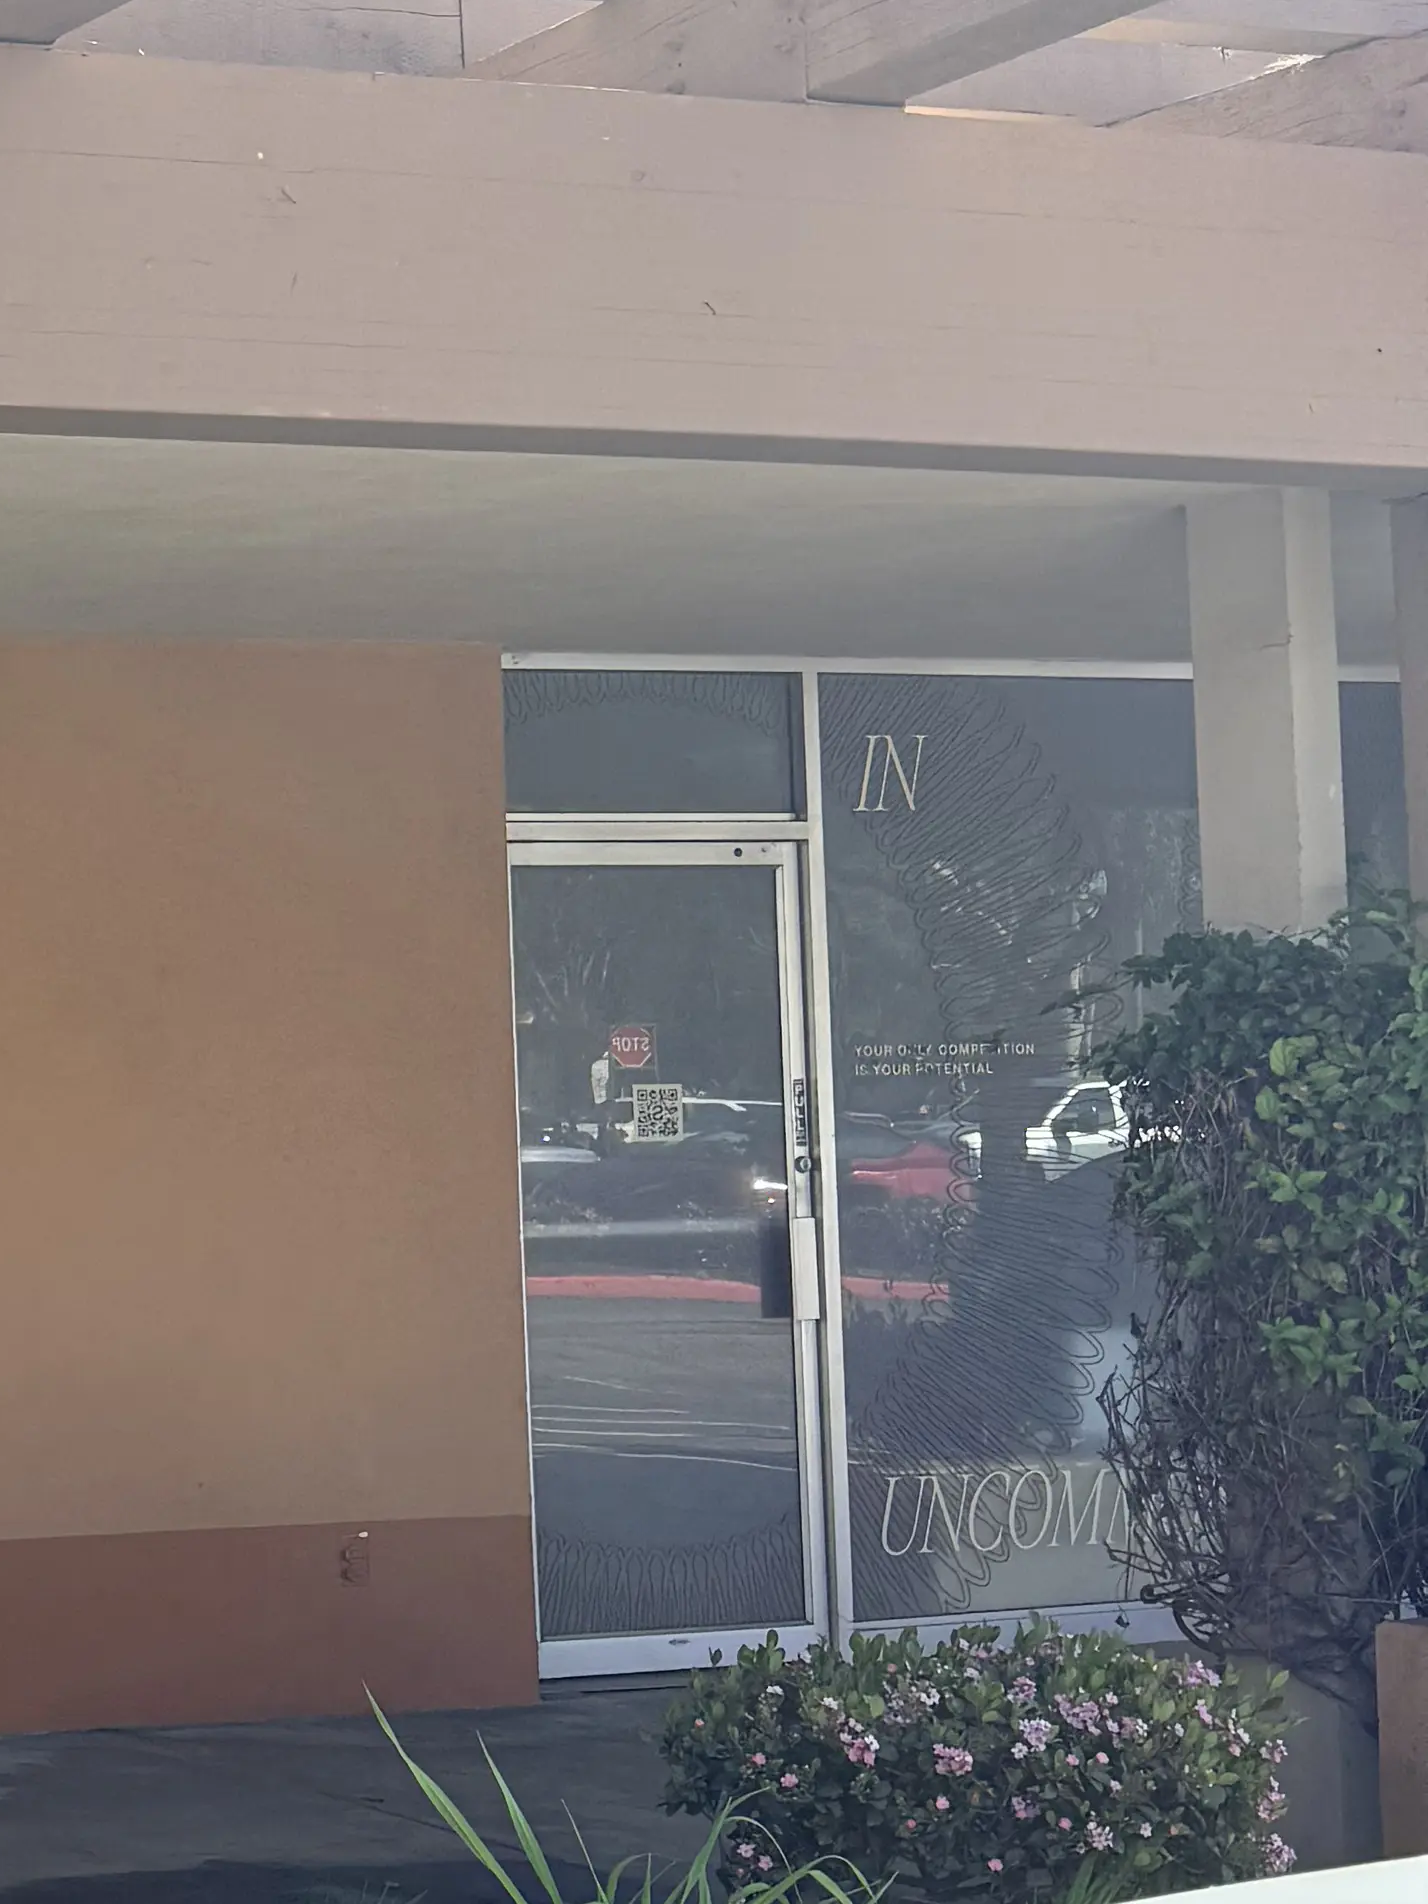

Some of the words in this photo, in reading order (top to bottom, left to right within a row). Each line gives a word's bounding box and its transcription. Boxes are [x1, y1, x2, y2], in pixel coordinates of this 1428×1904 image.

[852, 735, 929, 811] IN
[938, 1043, 1035, 1056] COMPEITION
[873, 1064, 911, 1076] YOUR
[794, 1084, 806, 1131] PULL
